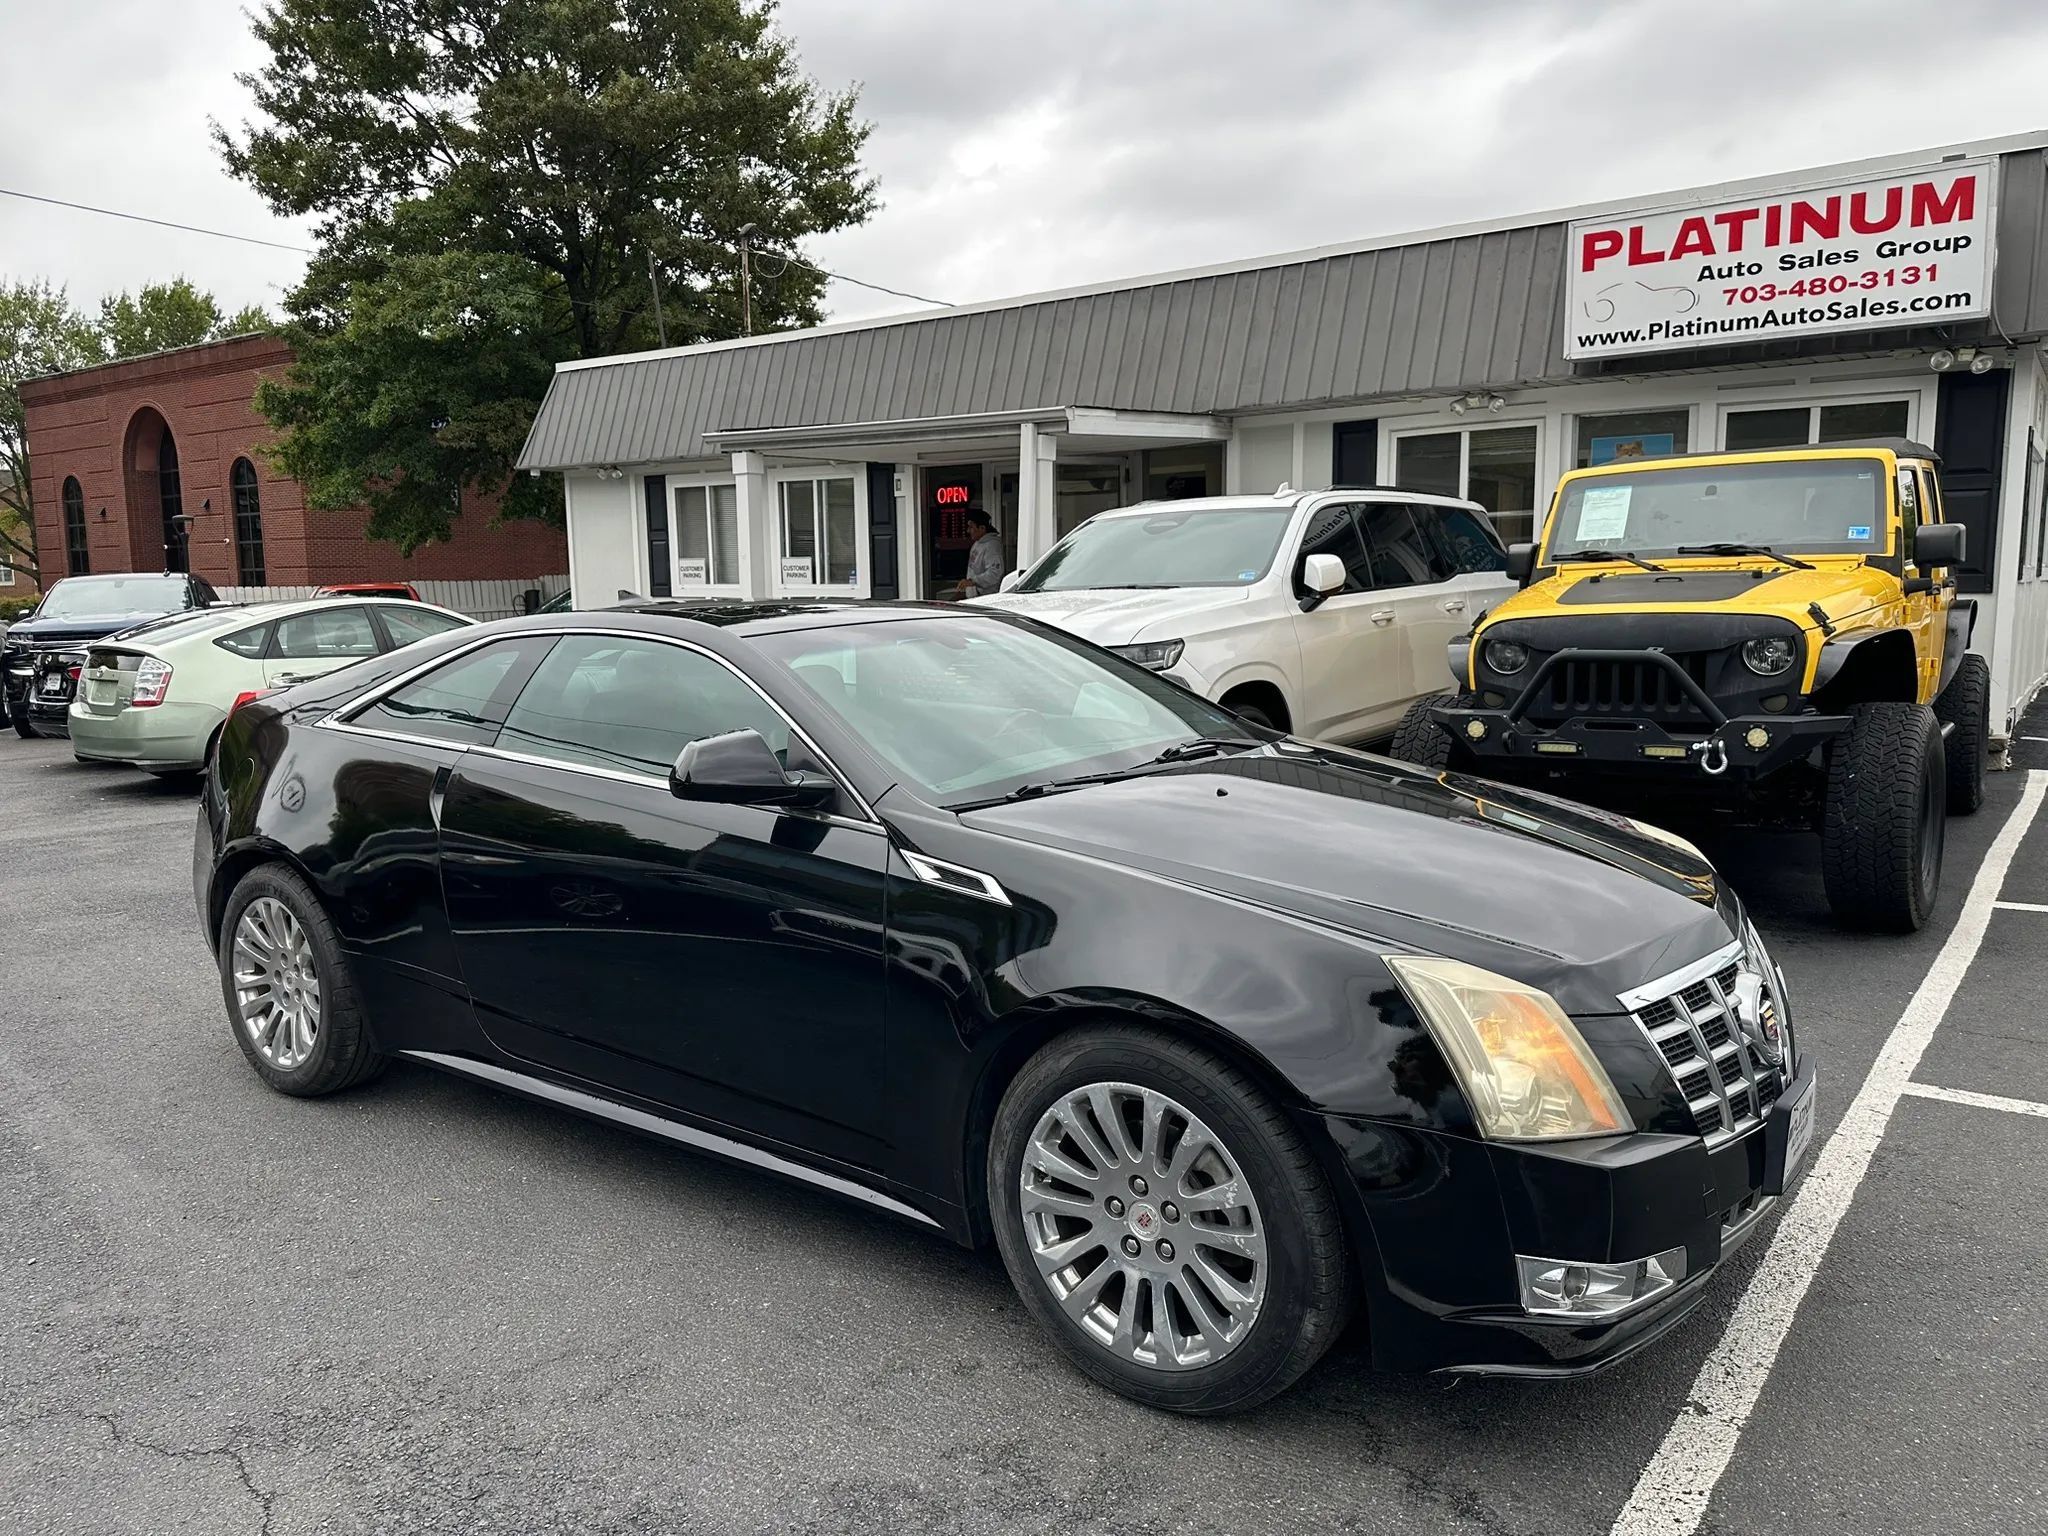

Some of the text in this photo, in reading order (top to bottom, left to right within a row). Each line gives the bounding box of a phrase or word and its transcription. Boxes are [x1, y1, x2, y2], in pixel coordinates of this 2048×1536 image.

[1582, 176, 1976, 273] PLATINUM
[1697, 235, 1972, 282] Auto Sales Group
[1722, 264, 1938, 306] 703-480-3131
[1577, 292, 1971, 348] www.PlatinumAutoSales.com
[937, 486, 968, 504] OPEN
[786, 571, 808, 579] PARKING
